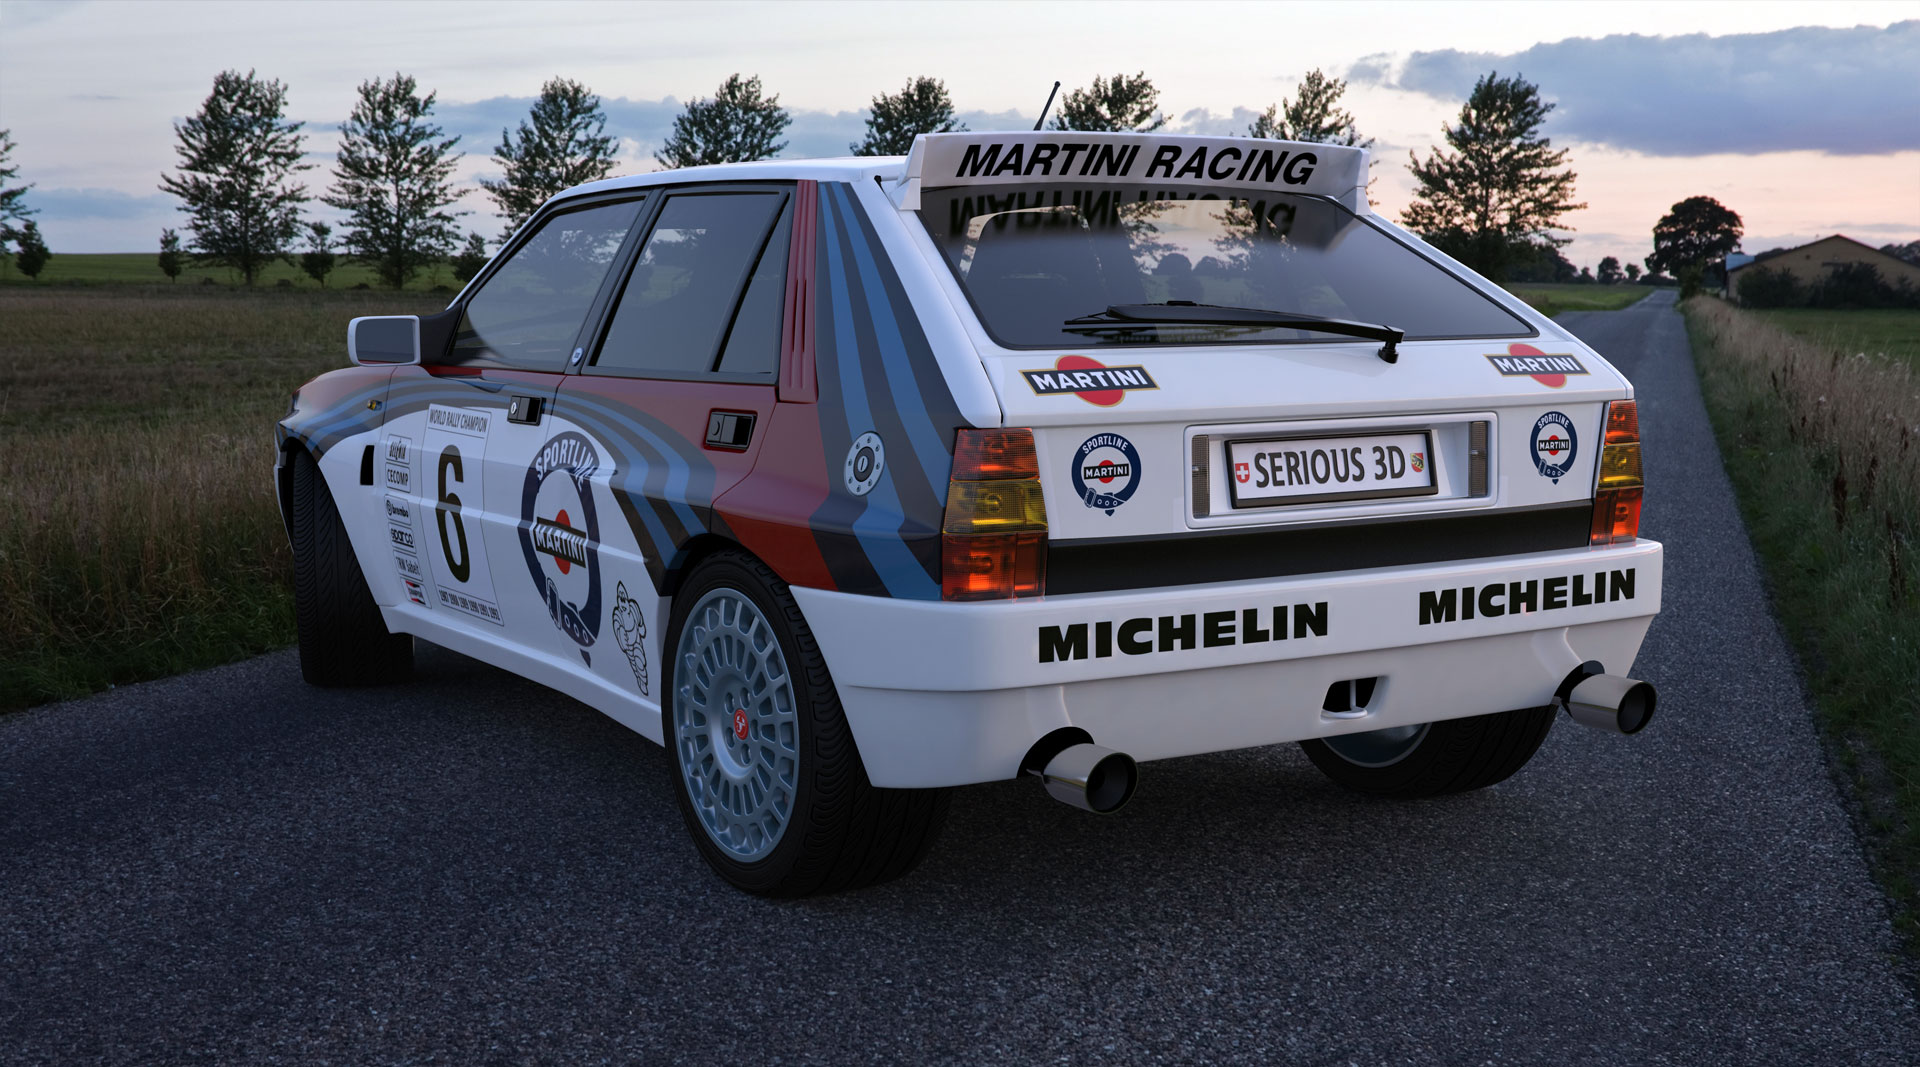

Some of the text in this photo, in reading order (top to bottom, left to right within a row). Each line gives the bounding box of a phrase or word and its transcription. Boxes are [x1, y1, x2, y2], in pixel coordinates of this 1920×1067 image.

[955, 143, 1319, 185] MARTINI RACING
[1493, 356, 1581, 373] MARTINI
[1030, 369, 1149, 391] MARTINI
[429, 408, 489, 432] WORLD RALLY CHAMPION
[1537, 413, 1570, 429] SPORTLINE
[1082, 435, 1129, 455] SPORTLINE
[1539, 440, 1569, 451] MARTINI
[386, 469, 409, 486] CECOMP
[1085, 463, 1128, 478] MARTINI
[1253, 445, 1406, 489] SERIOUS 3D
[435, 444, 470, 583] 6
[390, 528, 414, 545] sparco
[534, 523, 588, 563] MARTINI
[1419, 568, 1636, 625] MICHELIN
[1038, 601, 1329, 664] MICHELIN
